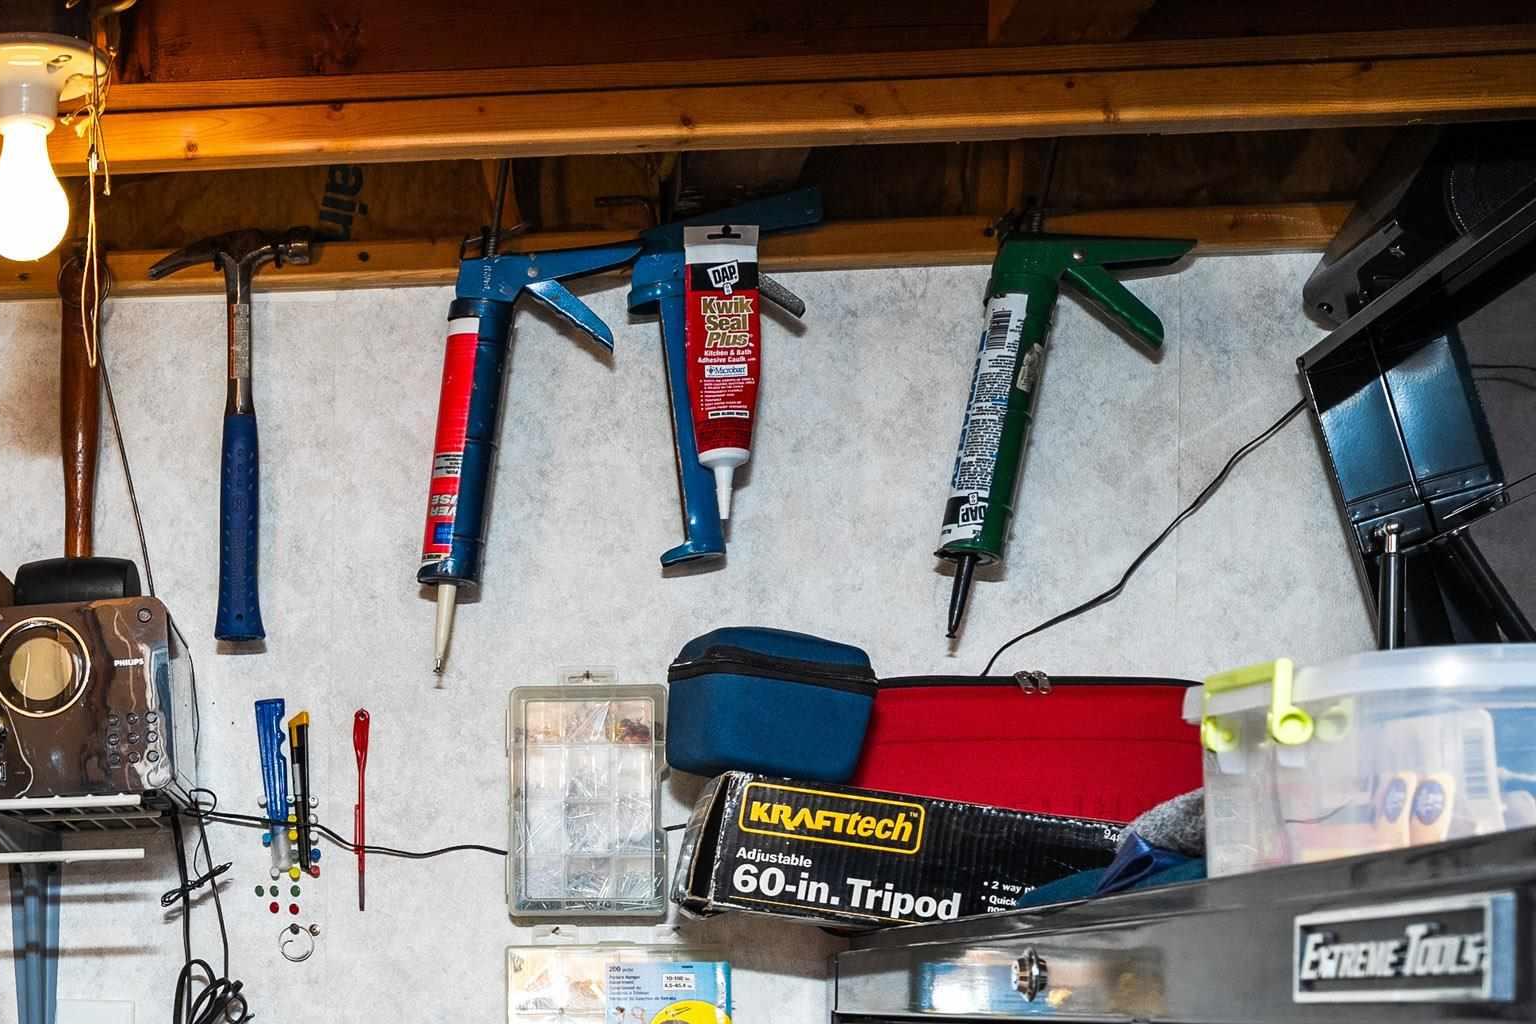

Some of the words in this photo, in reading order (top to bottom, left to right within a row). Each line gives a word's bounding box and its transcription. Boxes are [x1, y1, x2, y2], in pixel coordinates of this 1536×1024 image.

[701, 295, 754, 316] Kwik
[705, 313, 749, 332] Seal
[705, 330, 750, 348] Plus
[114, 658, 144, 667] PHILIPS
[749, 800, 913, 844] KRAFTtech
[736, 846, 813, 869] Adjustable
[731, 863, 839, 906] 60-in.
[846, 878, 962, 921] Tripod
[991, 881, 1000, 890] 2
[1002, 883, 1022, 895] way
[989, 895, 1016, 907] Quick
